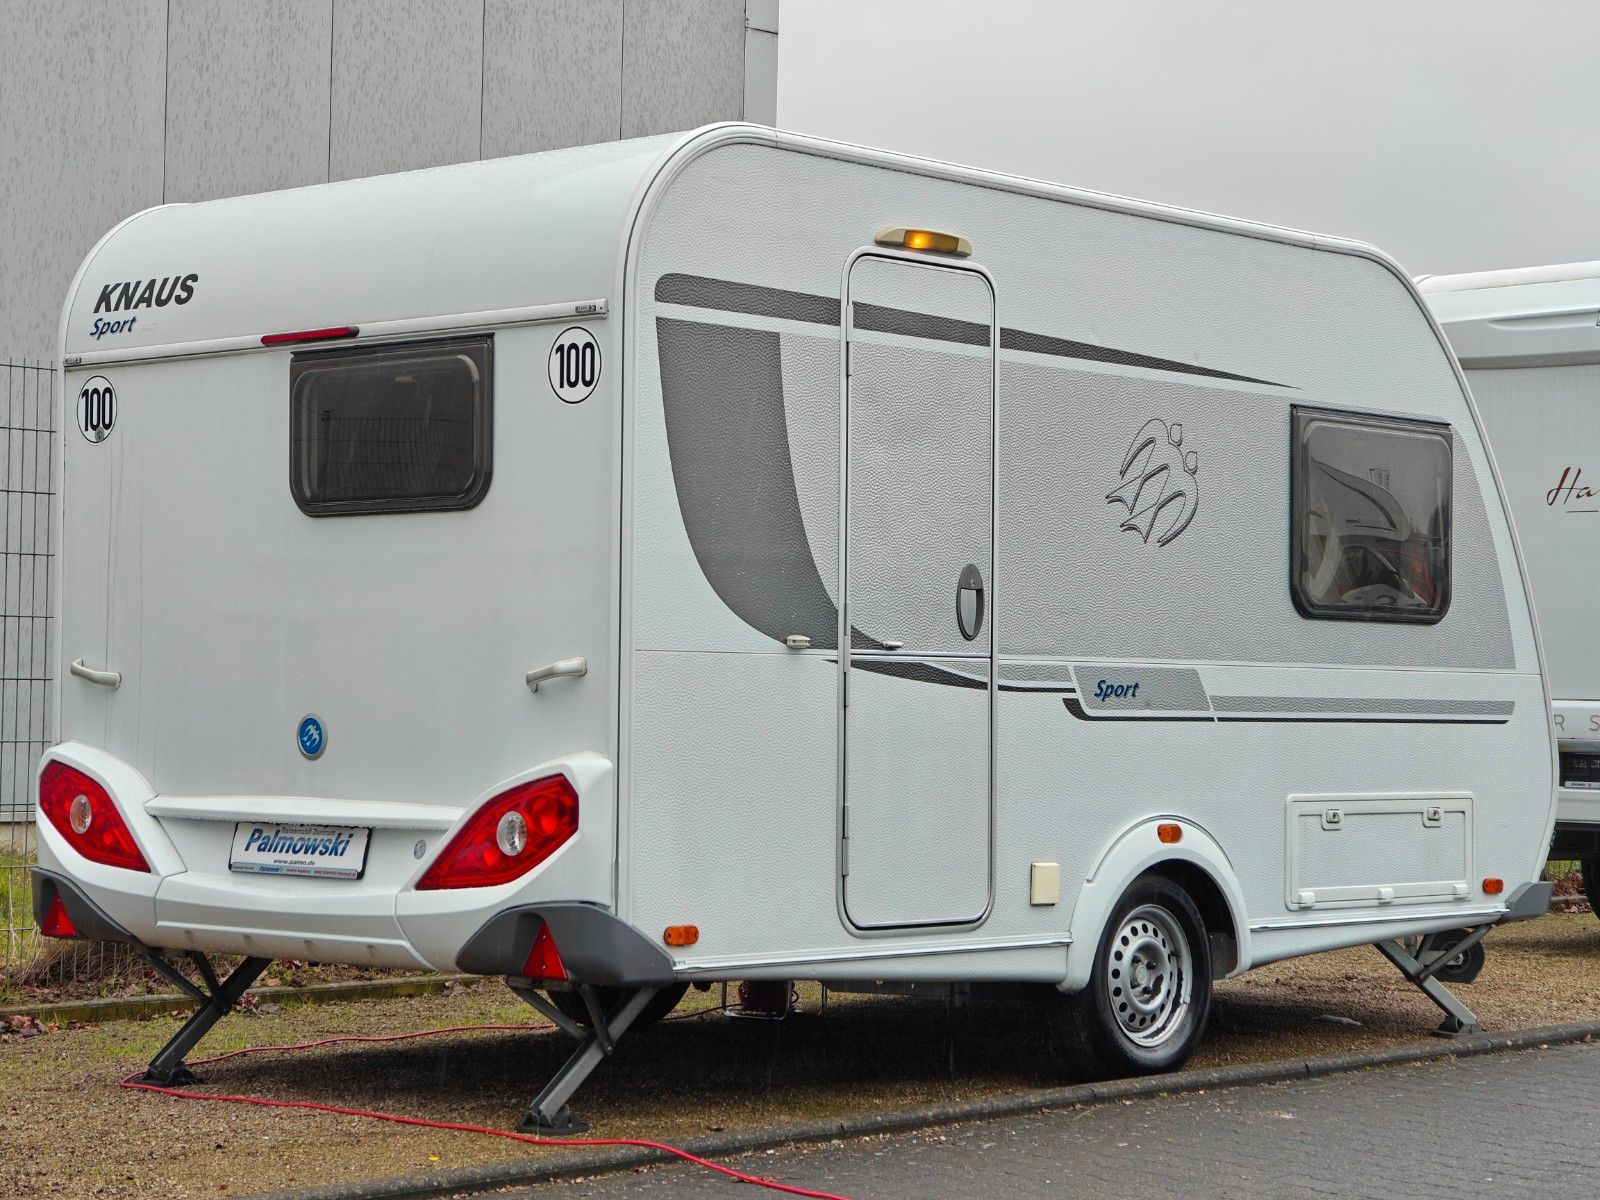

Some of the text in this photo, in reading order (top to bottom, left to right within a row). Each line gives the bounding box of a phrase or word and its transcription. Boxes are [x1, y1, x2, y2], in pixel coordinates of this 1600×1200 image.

[93, 273, 199, 314] KNAUS
[90, 316, 137, 341] Sport
[554, 341, 595, 389] 100
[81, 386, 113, 432] 100
[1094, 679, 1140, 702] Sport
[244, 827, 355, 857] Palmowski
[273, 859, 316, 867] www.palmo.de
